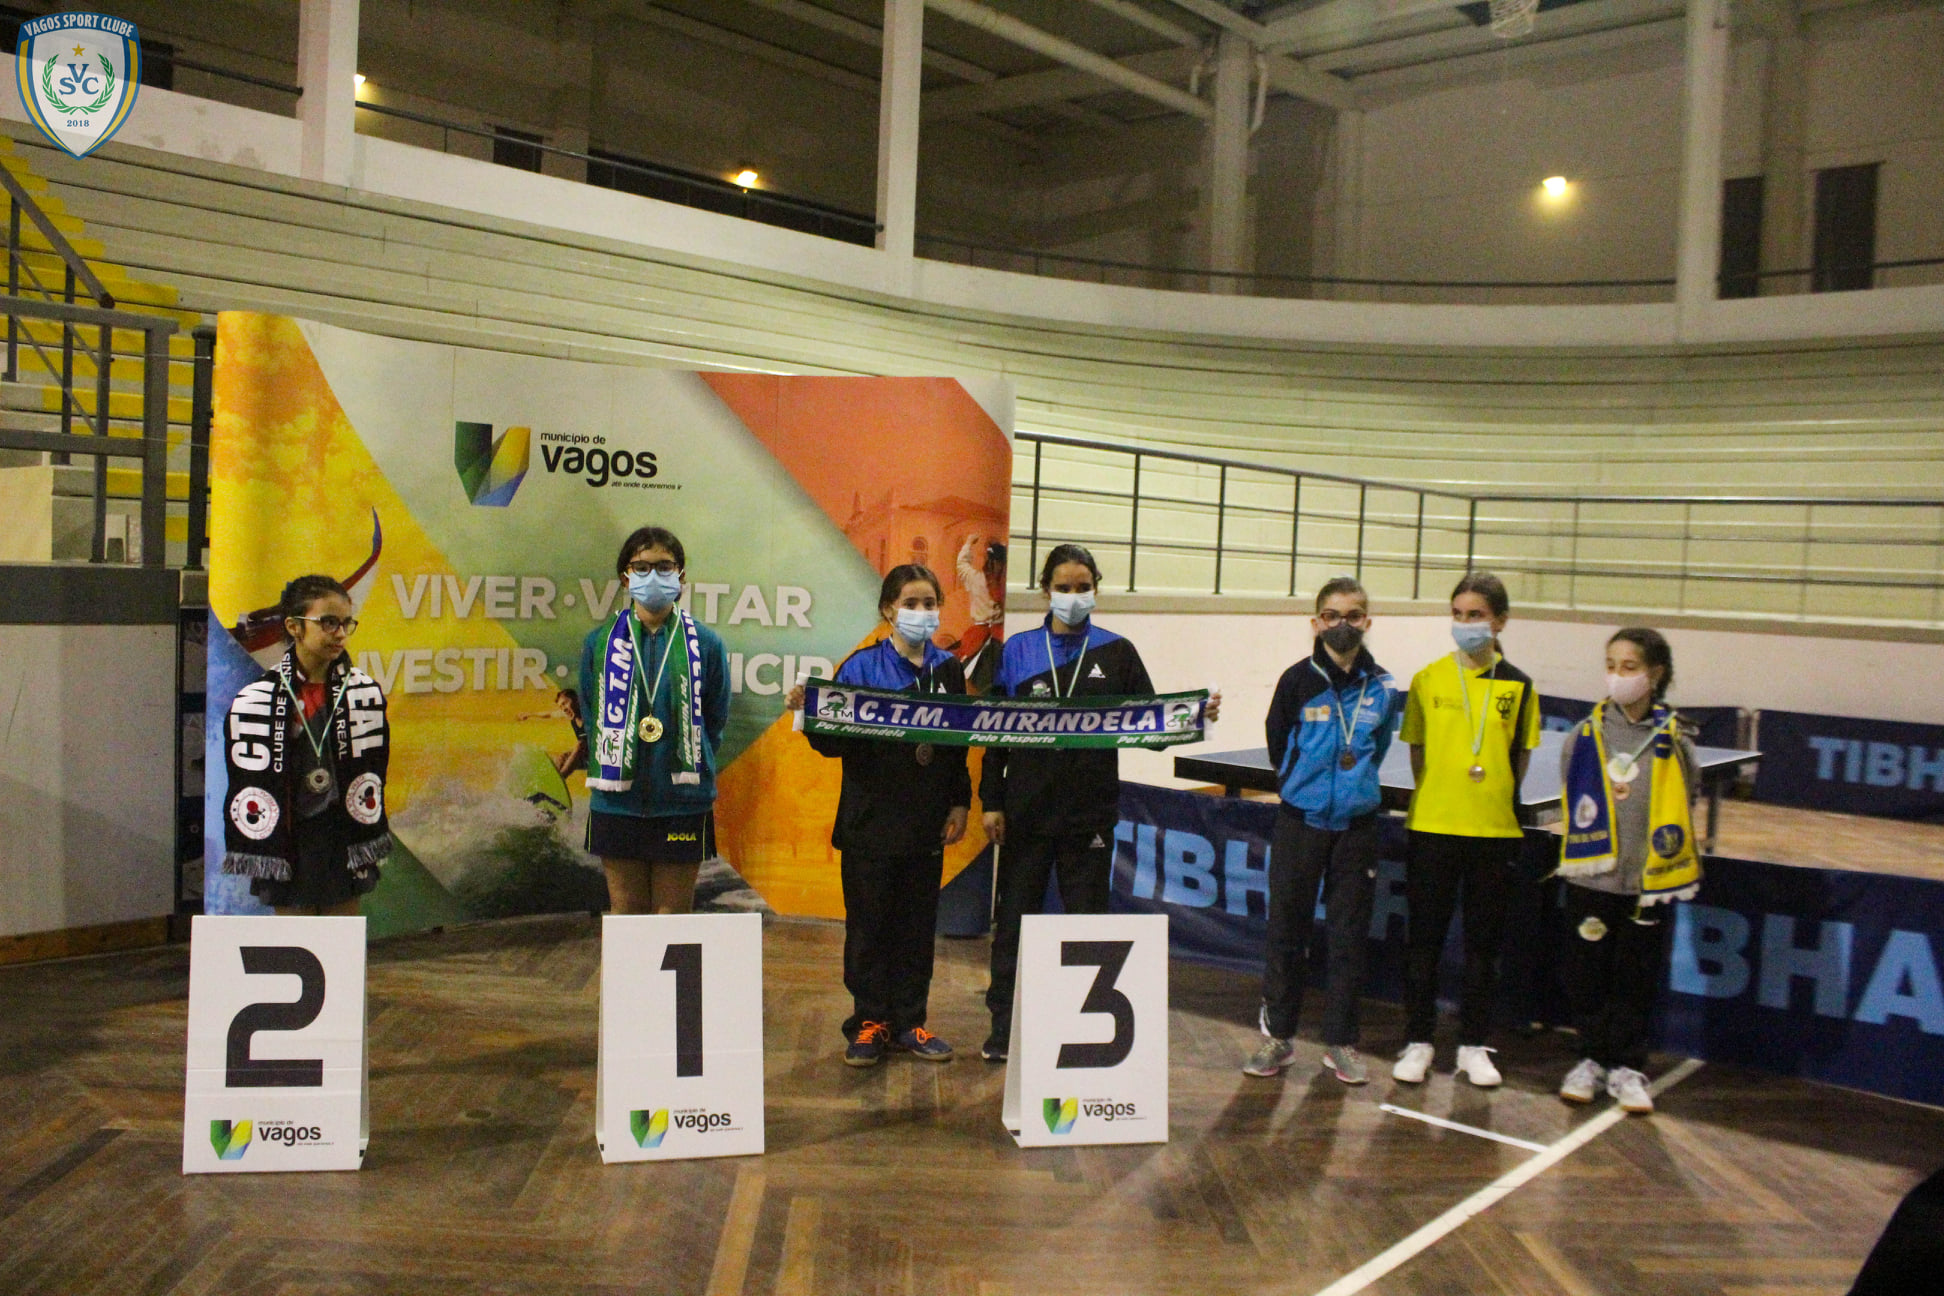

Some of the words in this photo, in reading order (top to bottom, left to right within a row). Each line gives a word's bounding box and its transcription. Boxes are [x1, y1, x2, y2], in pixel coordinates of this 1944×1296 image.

[592, 434, 606, 445] de
[541, 445, 658, 487] vagos
[391, 574, 556, 620] VIVER
[275, 697, 288, 717] DE
[858, 701, 950, 728] C.T.M.
[972, 709, 1157, 733] MIRANDELA
[229, 681, 276, 772] CTM
[335, 719, 348, 760] REAL
[815, 720, 840, 731] Por
[840, 724, 905, 738] Mirandela
[968, 733, 999, 743] Pelo
[1000, 734, 1056, 744] Desporto
[1117, 735, 1140, 744] Por
[273, 720, 286, 773] CLUBE
[666, 832, 697, 842] JOOLA
[225, 946, 326, 1088] 2
[660, 943, 703, 1078] 1
[1056, 940, 1136, 1069] 3
[674, 1113, 732, 1133] vagos
[1083, 1103, 1136, 1122] vagos
[259, 1126, 321, 1147] vagos
